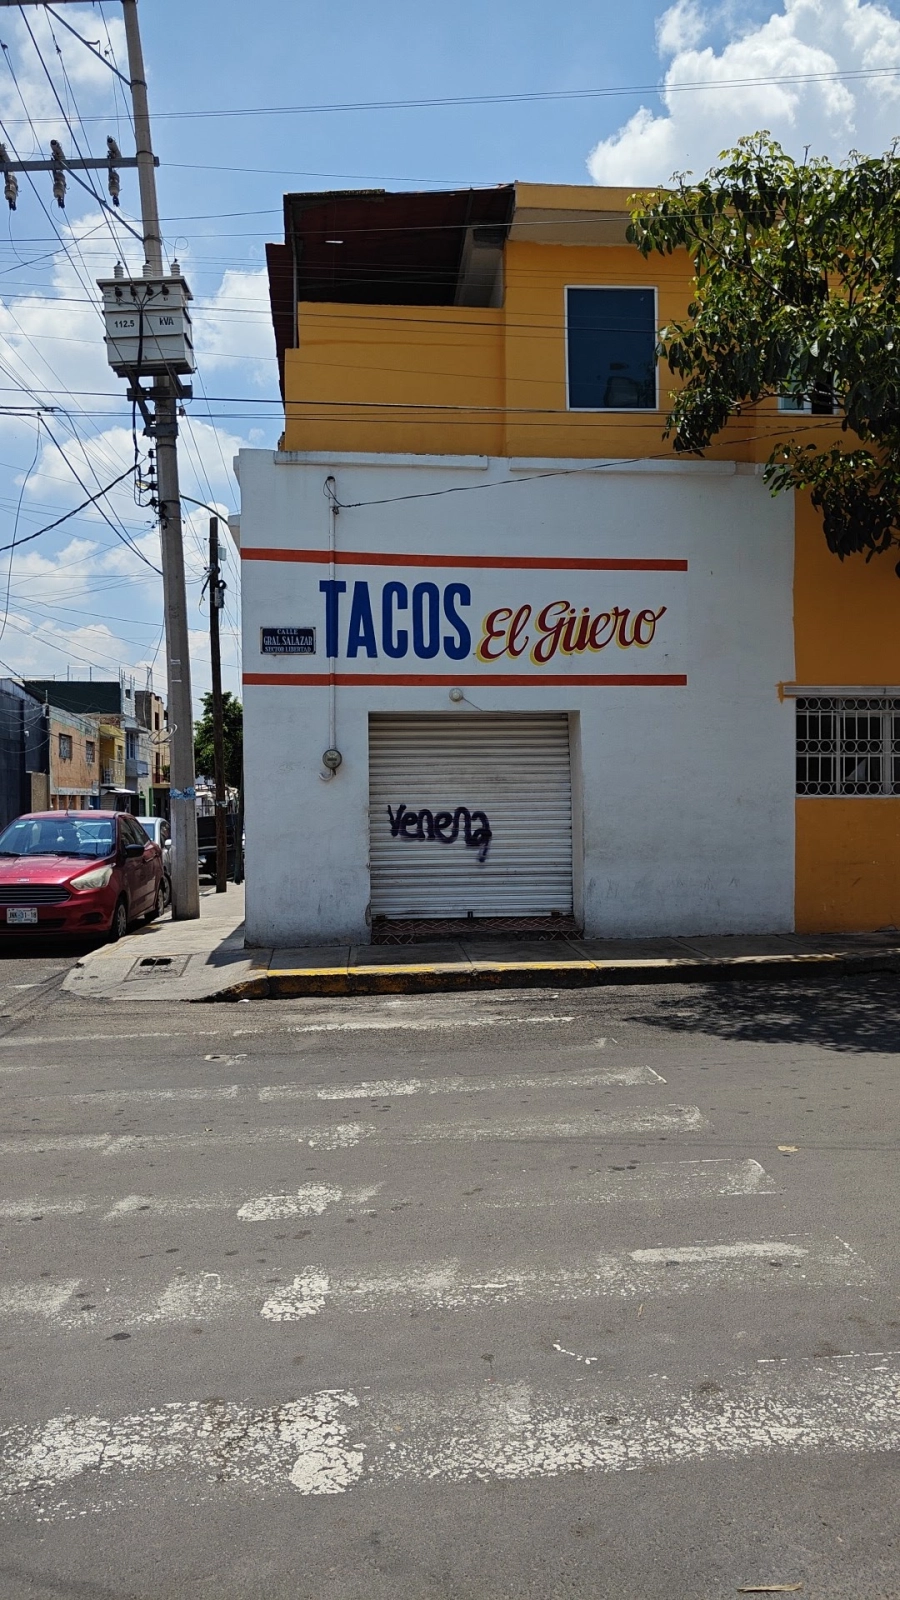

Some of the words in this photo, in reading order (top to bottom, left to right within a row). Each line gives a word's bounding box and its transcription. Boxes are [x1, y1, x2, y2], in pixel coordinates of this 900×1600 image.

[114, 320, 134, 328] 112.5
[319, 580, 472, 660] TACOS
[476, 604, 532, 663] El
[529, 600, 668, 667] Güero
[264, 636, 280, 646] GRAL
[282, 636, 312, 646] SALAZAR
